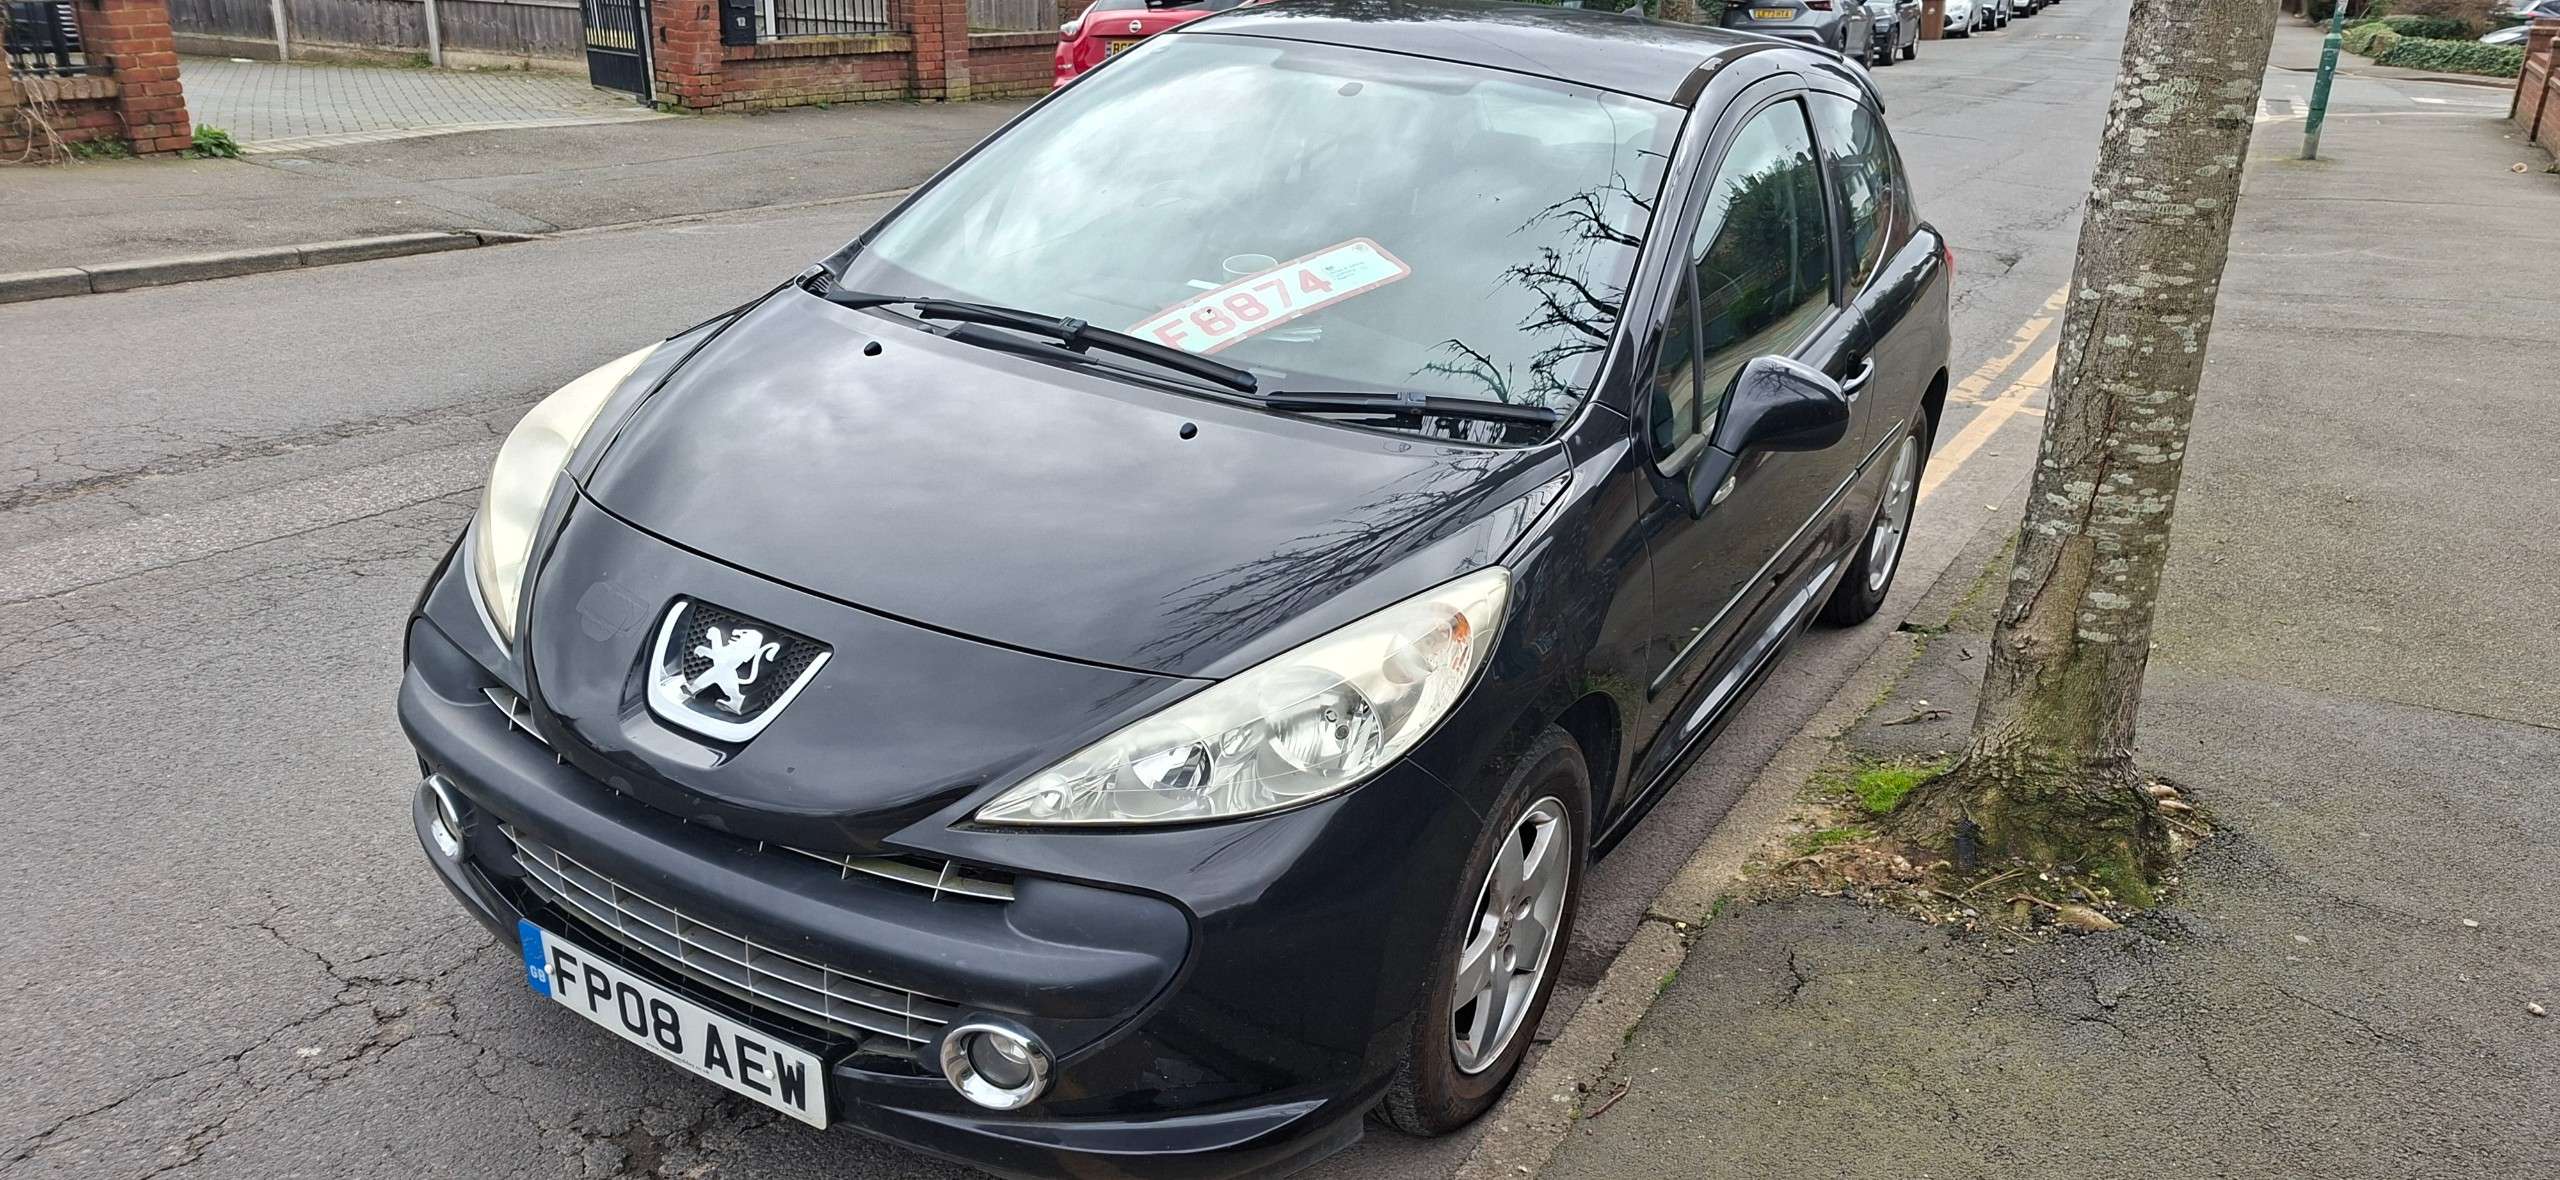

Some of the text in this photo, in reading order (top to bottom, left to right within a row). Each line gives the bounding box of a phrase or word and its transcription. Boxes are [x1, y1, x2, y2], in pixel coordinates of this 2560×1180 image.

[695, 4, 710, 20] 12
[529, 965, 546, 983] GB
[551, 945, 806, 1112] FP08 AEW
